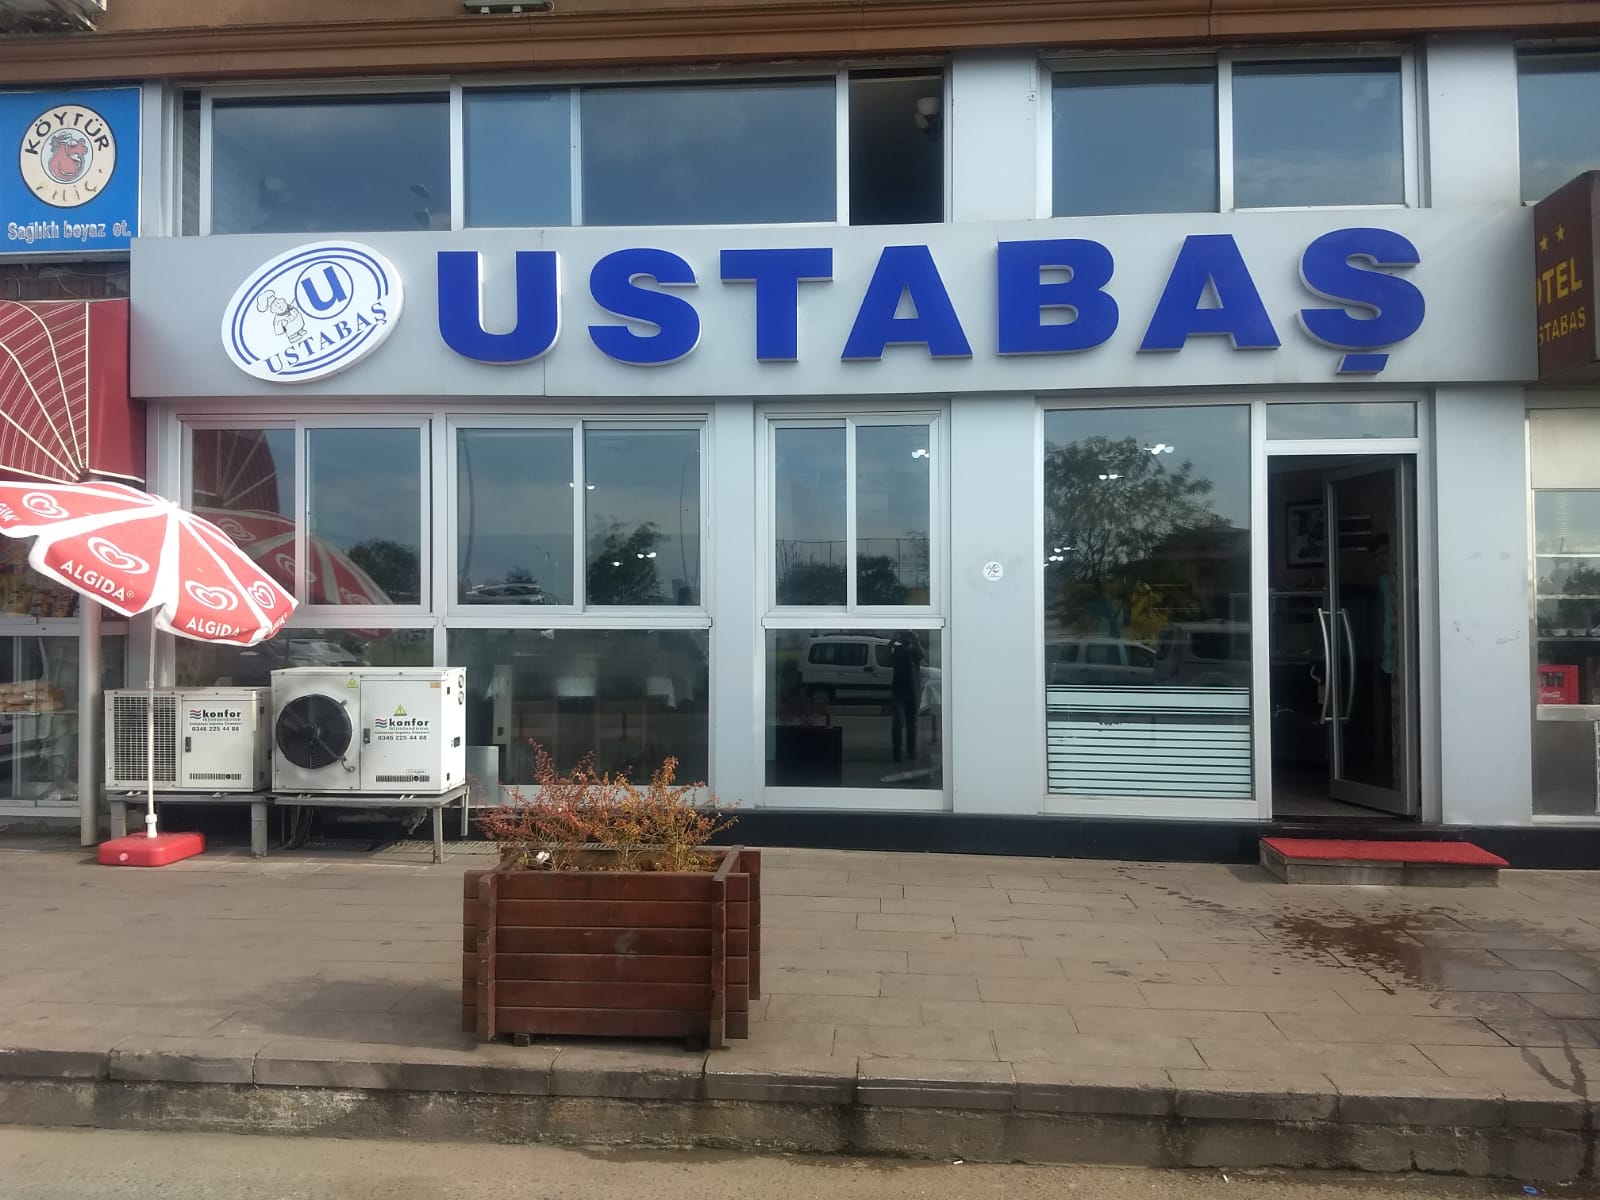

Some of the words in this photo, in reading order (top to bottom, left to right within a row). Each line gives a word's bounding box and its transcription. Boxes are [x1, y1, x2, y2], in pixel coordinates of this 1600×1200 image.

[24, 111, 110, 155] KÖYTÜR
[7, 221, 60, 244] Sağlıklı
[63, 220, 106, 242] beyaz
[436, 226, 1426, 376] USTABAŞ
[1537, 256, 1583, 305] TEL
[264, 302, 387, 374] USTABAŞ
[202, 709, 242, 718] konfor
[389, 717, 429, 727] konfor
